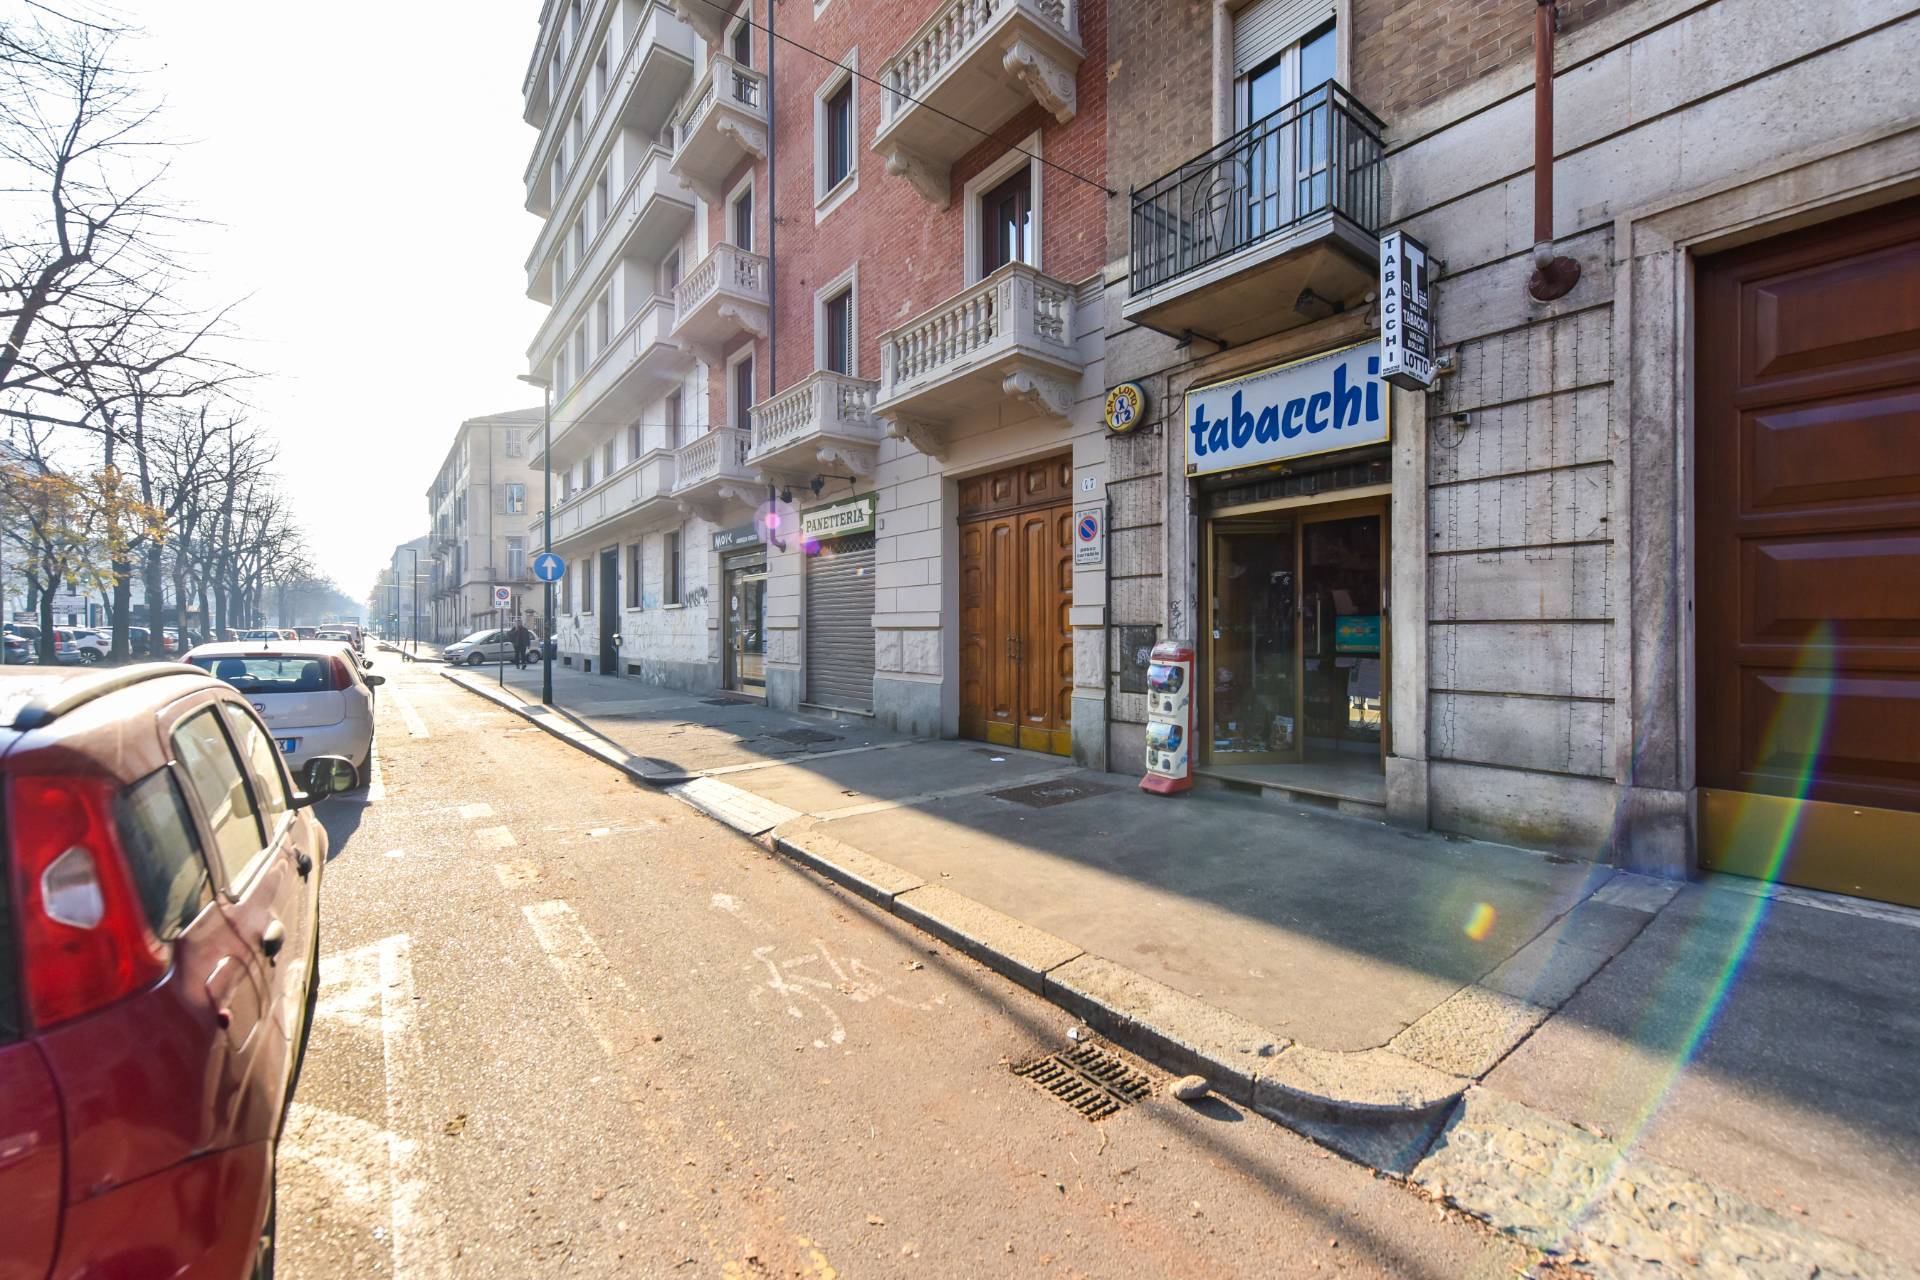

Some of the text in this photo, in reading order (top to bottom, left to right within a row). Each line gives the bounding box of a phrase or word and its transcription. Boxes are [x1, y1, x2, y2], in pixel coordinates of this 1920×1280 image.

[1404, 240, 1425, 303] T
[1384, 237, 1397, 363] TABACCHI
[1403, 308, 1428, 334] TABACCHI
[1408, 330, 1425, 345] VALORI
[1403, 351, 1429, 375] LOTTO
[1118, 398, 1125, 411] X
[1124, 410, 1131, 422] 2
[1190, 356, 1380, 457] tabacchi
[805, 507, 865, 534] PANETTERIA
